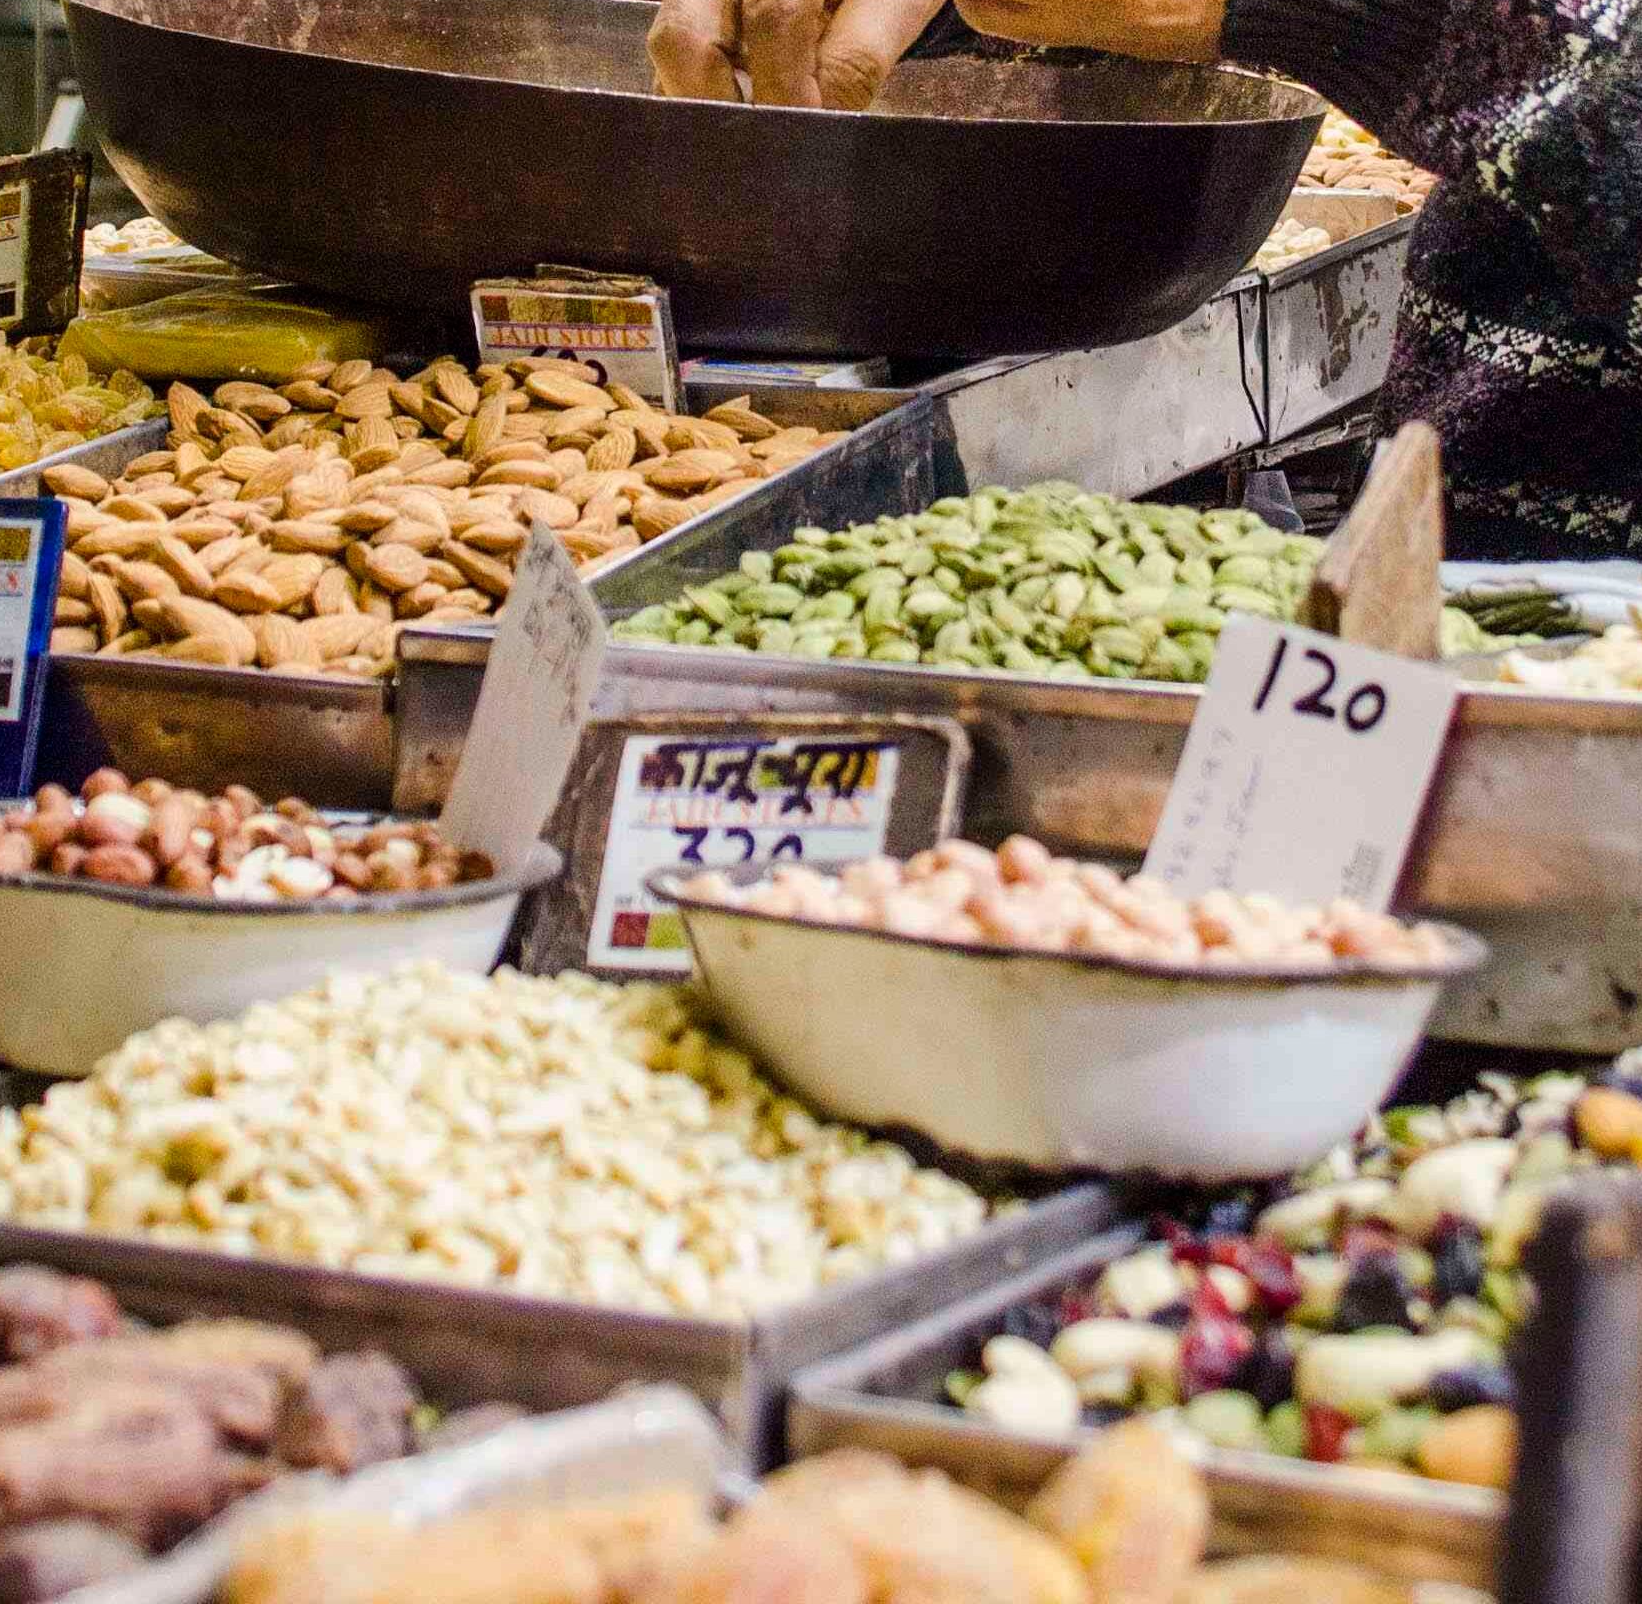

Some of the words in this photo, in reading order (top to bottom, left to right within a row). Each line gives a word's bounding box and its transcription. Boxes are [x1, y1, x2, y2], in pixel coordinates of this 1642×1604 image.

[491, 326, 550, 345] JAIN
[559, 327, 650, 349] STORES
[1253, 636, 1388, 733] 120
